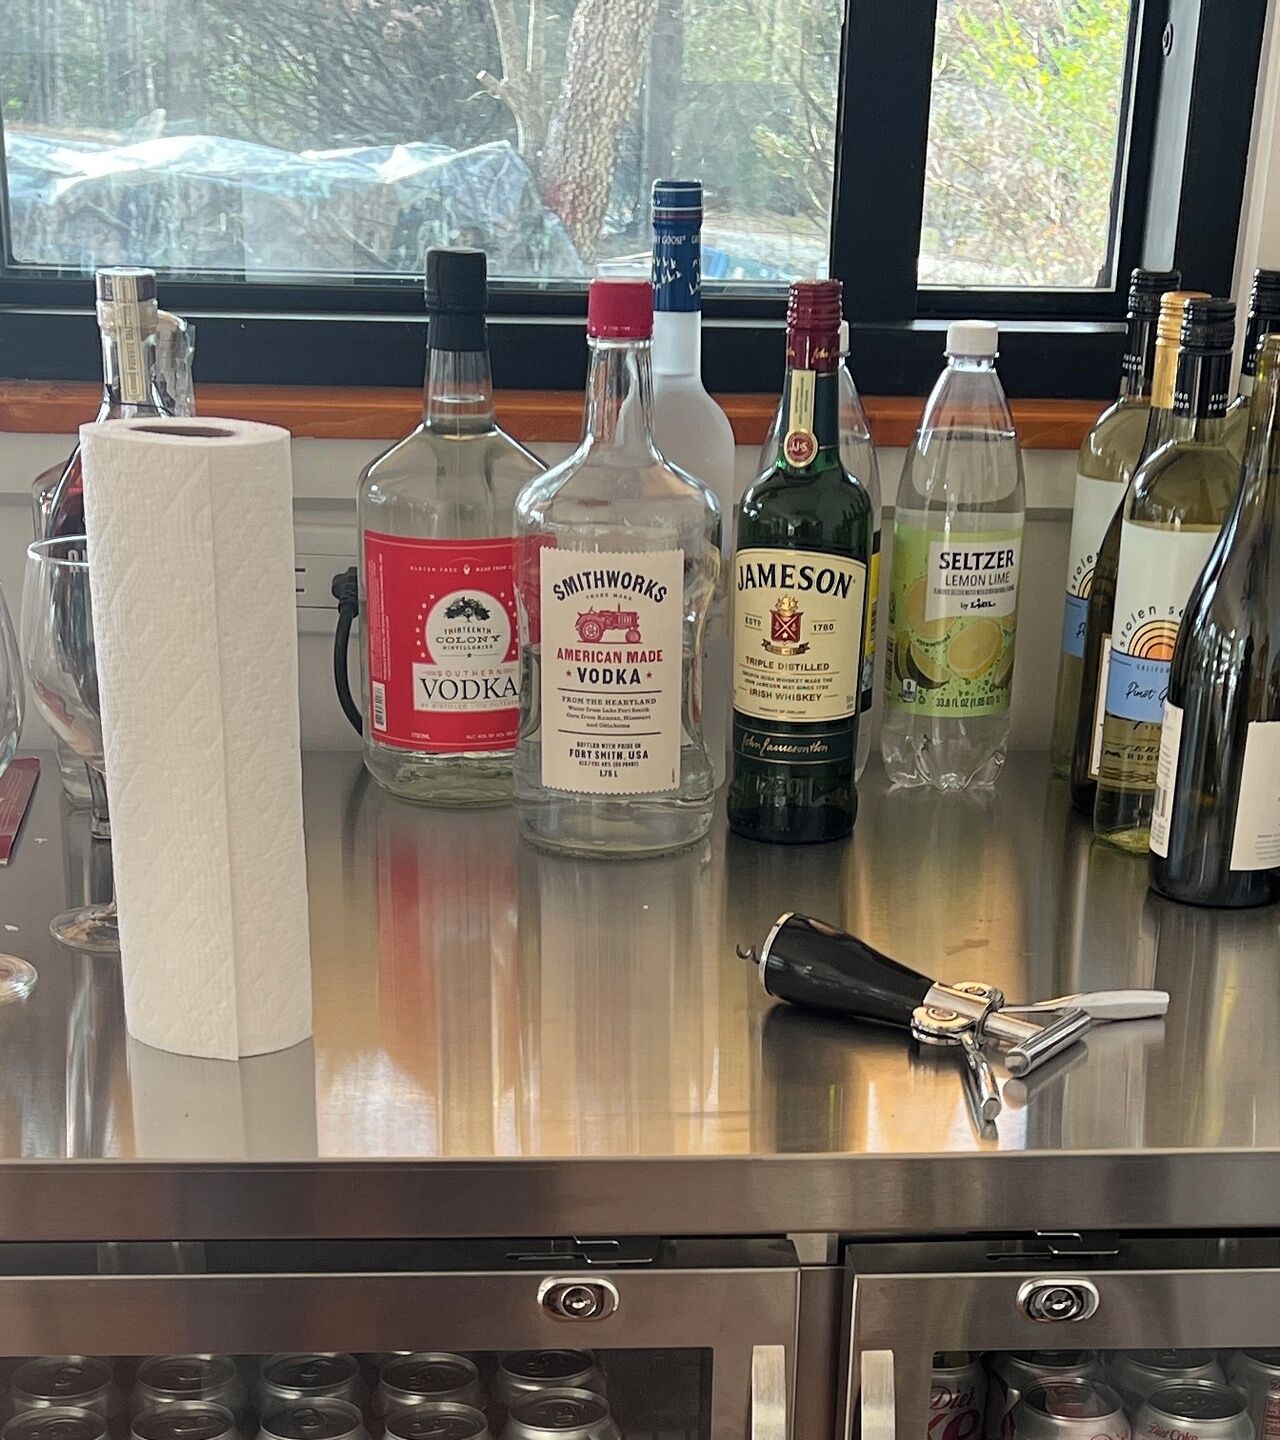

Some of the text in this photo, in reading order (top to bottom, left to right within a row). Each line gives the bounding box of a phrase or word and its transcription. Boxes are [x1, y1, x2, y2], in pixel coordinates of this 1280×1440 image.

[939, 549, 1015, 570] SELTZER
[946, 571, 1010, 587] LEMON LIME
[1070, 550, 1100, 591] stole
[553, 570, 667, 603] SMITHWORKS
[738, 563, 853, 599] JAMESON
[436, 634, 501, 645] COLONY
[444, 626, 492, 635] THIRTEENTH
[556, 648, 663, 664] AMERICAN MADE
[745, 655, 774, 669] TRIPLE
[577, 667, 641, 685] VODKA
[420, 677, 518, 700] VODKA
[749, 688, 822, 702] IRISH WHISKEY
[1125, 681, 1154, 701] Pinot
[569, 748, 592, 759] FORT
[628, 750, 649, 759] USA
[929, 1386, 975, 1411] Diet
[1148, 1422, 1169, 1440] Diet
